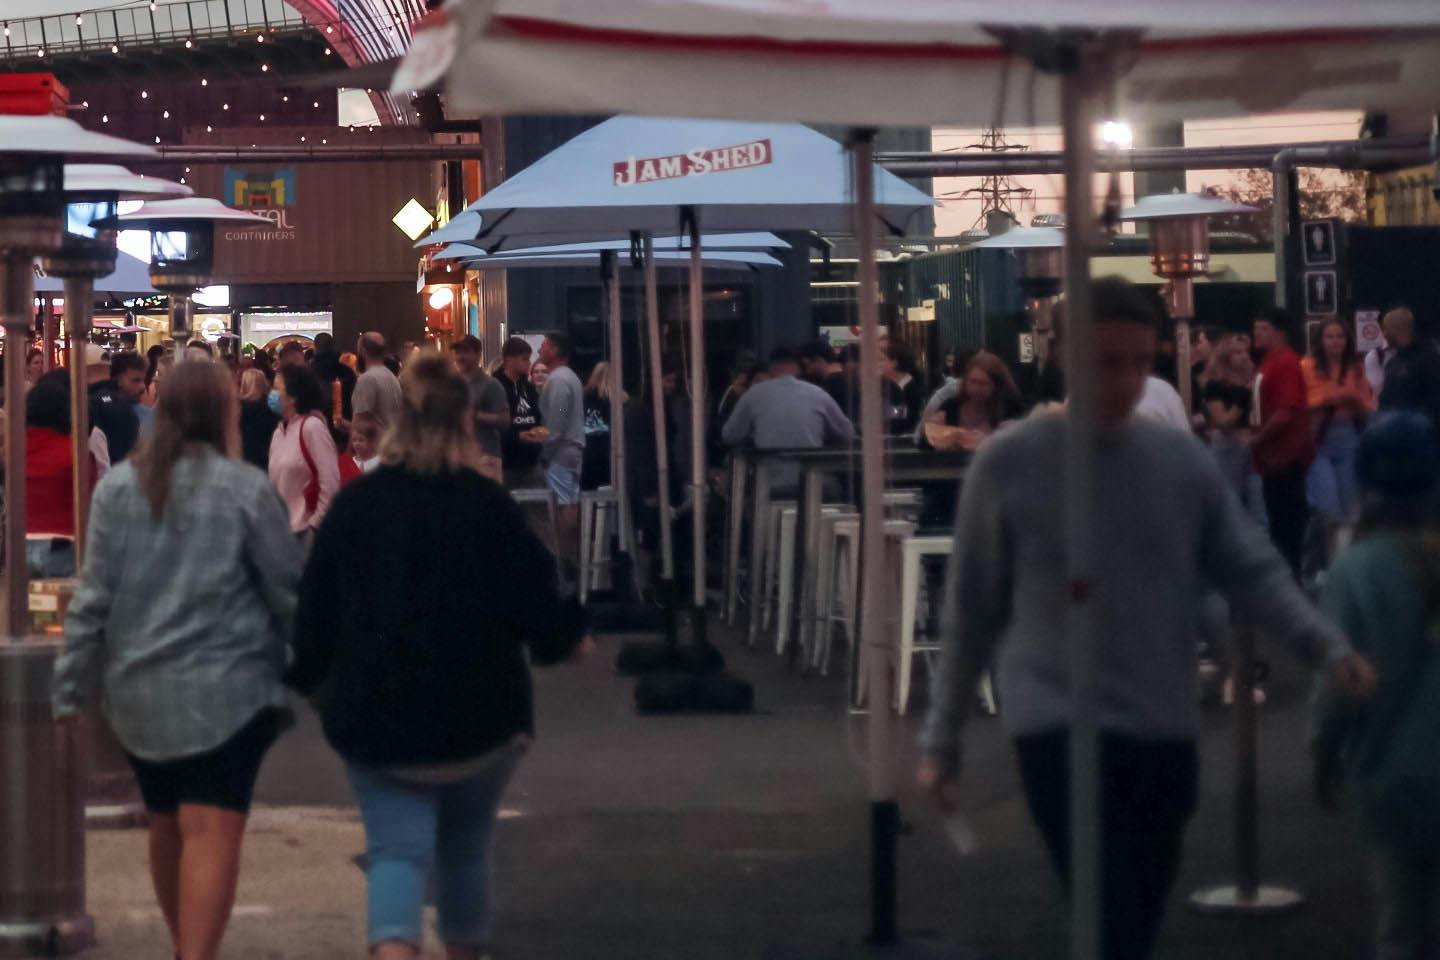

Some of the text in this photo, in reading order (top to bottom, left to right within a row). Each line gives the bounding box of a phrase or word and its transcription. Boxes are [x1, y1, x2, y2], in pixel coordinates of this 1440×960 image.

[616, 142, 767, 186] JAM SHED
[225, 231, 295, 240] CONTAINERS
